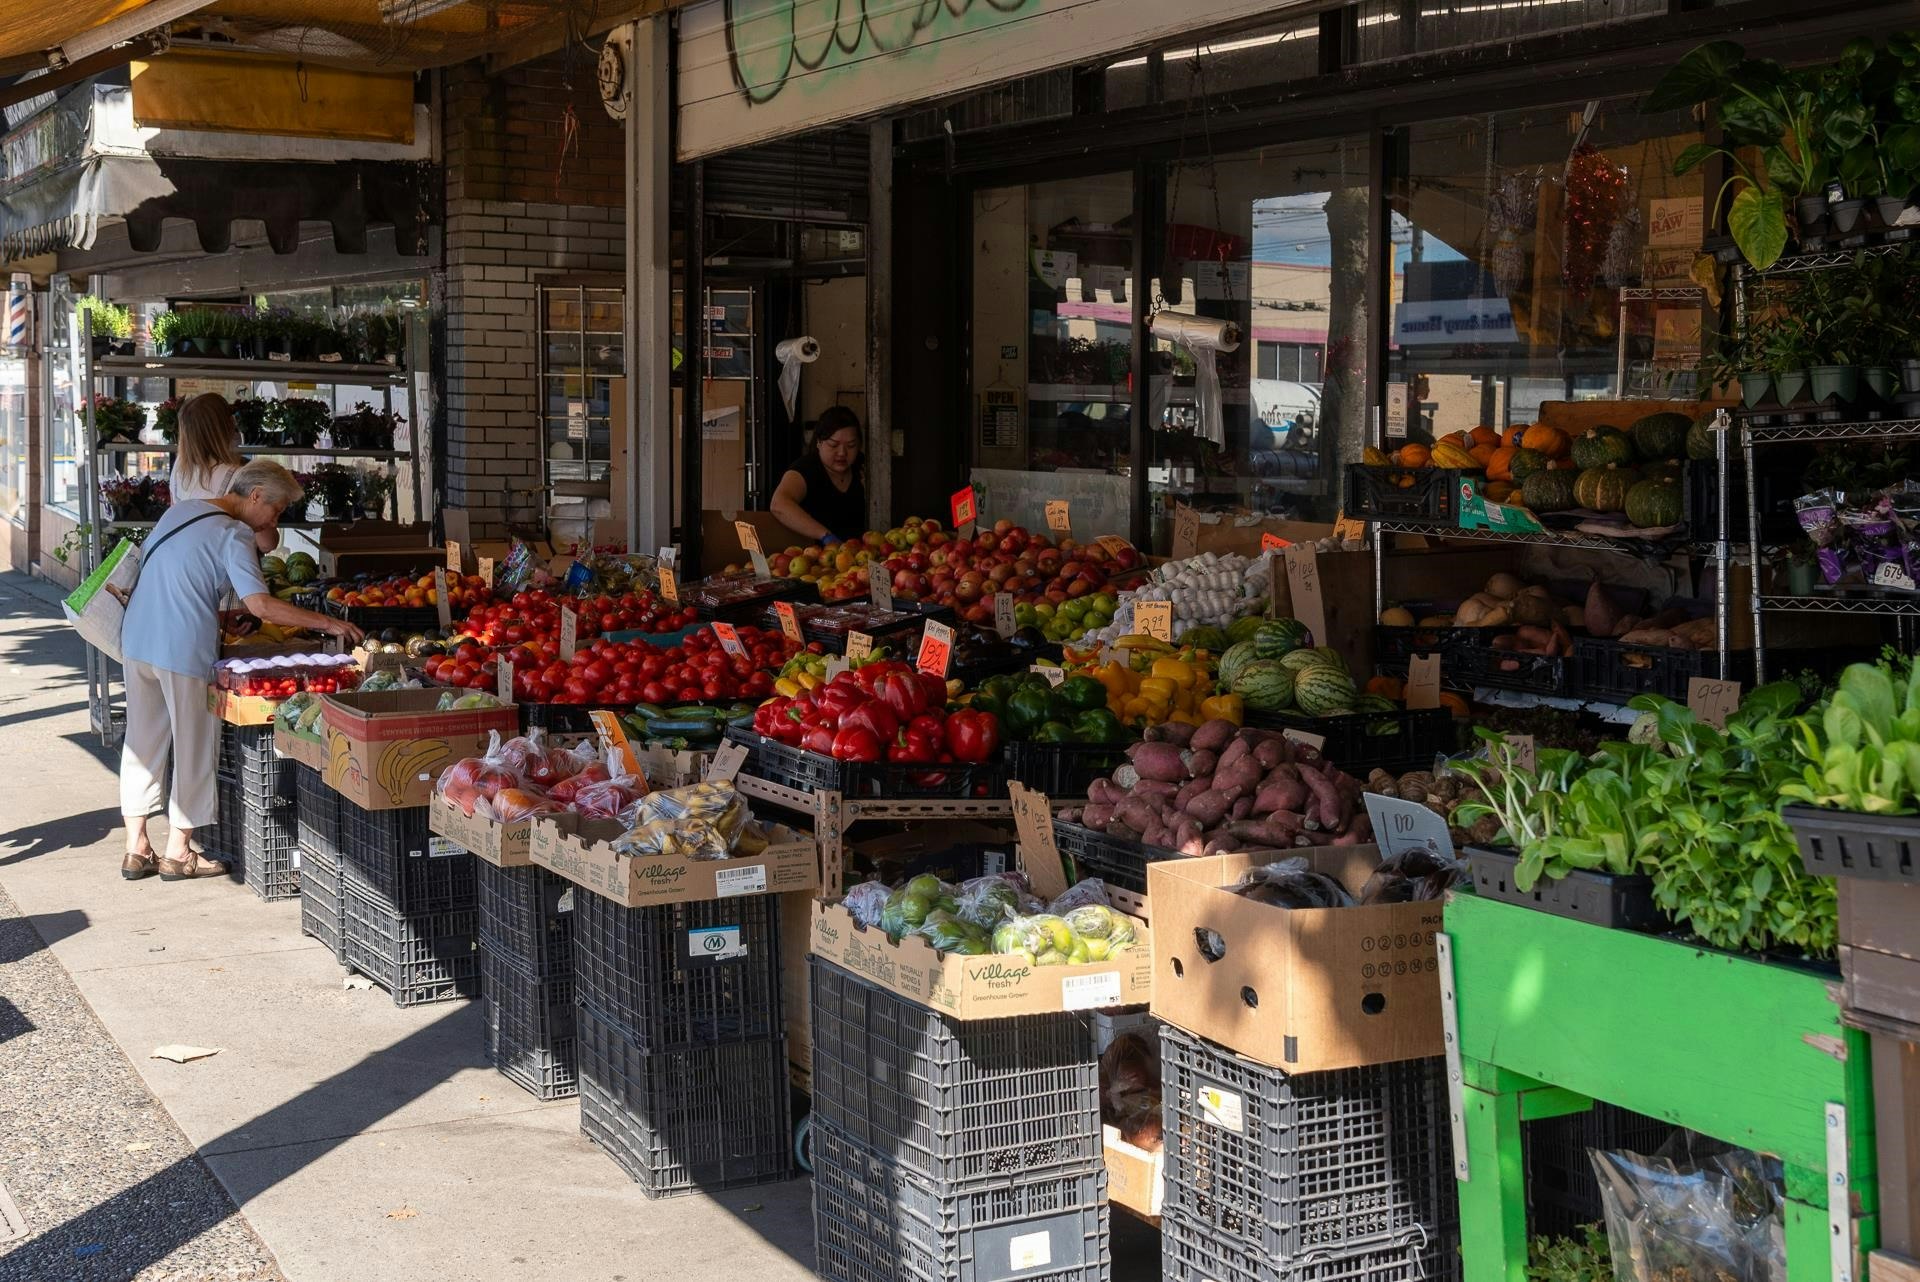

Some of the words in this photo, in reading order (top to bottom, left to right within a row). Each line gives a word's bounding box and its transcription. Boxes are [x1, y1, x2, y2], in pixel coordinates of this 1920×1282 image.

[1651, 215, 1683, 234] RAW
[987, 391, 1014, 404] OPEN
[634, 864, 687, 882] Village
[651, 877, 672, 886] fresh
[969, 962, 1031, 984] Village
[987, 978, 1011, 990] fresh
[972, 993, 1007, 1002] Greenhouse
